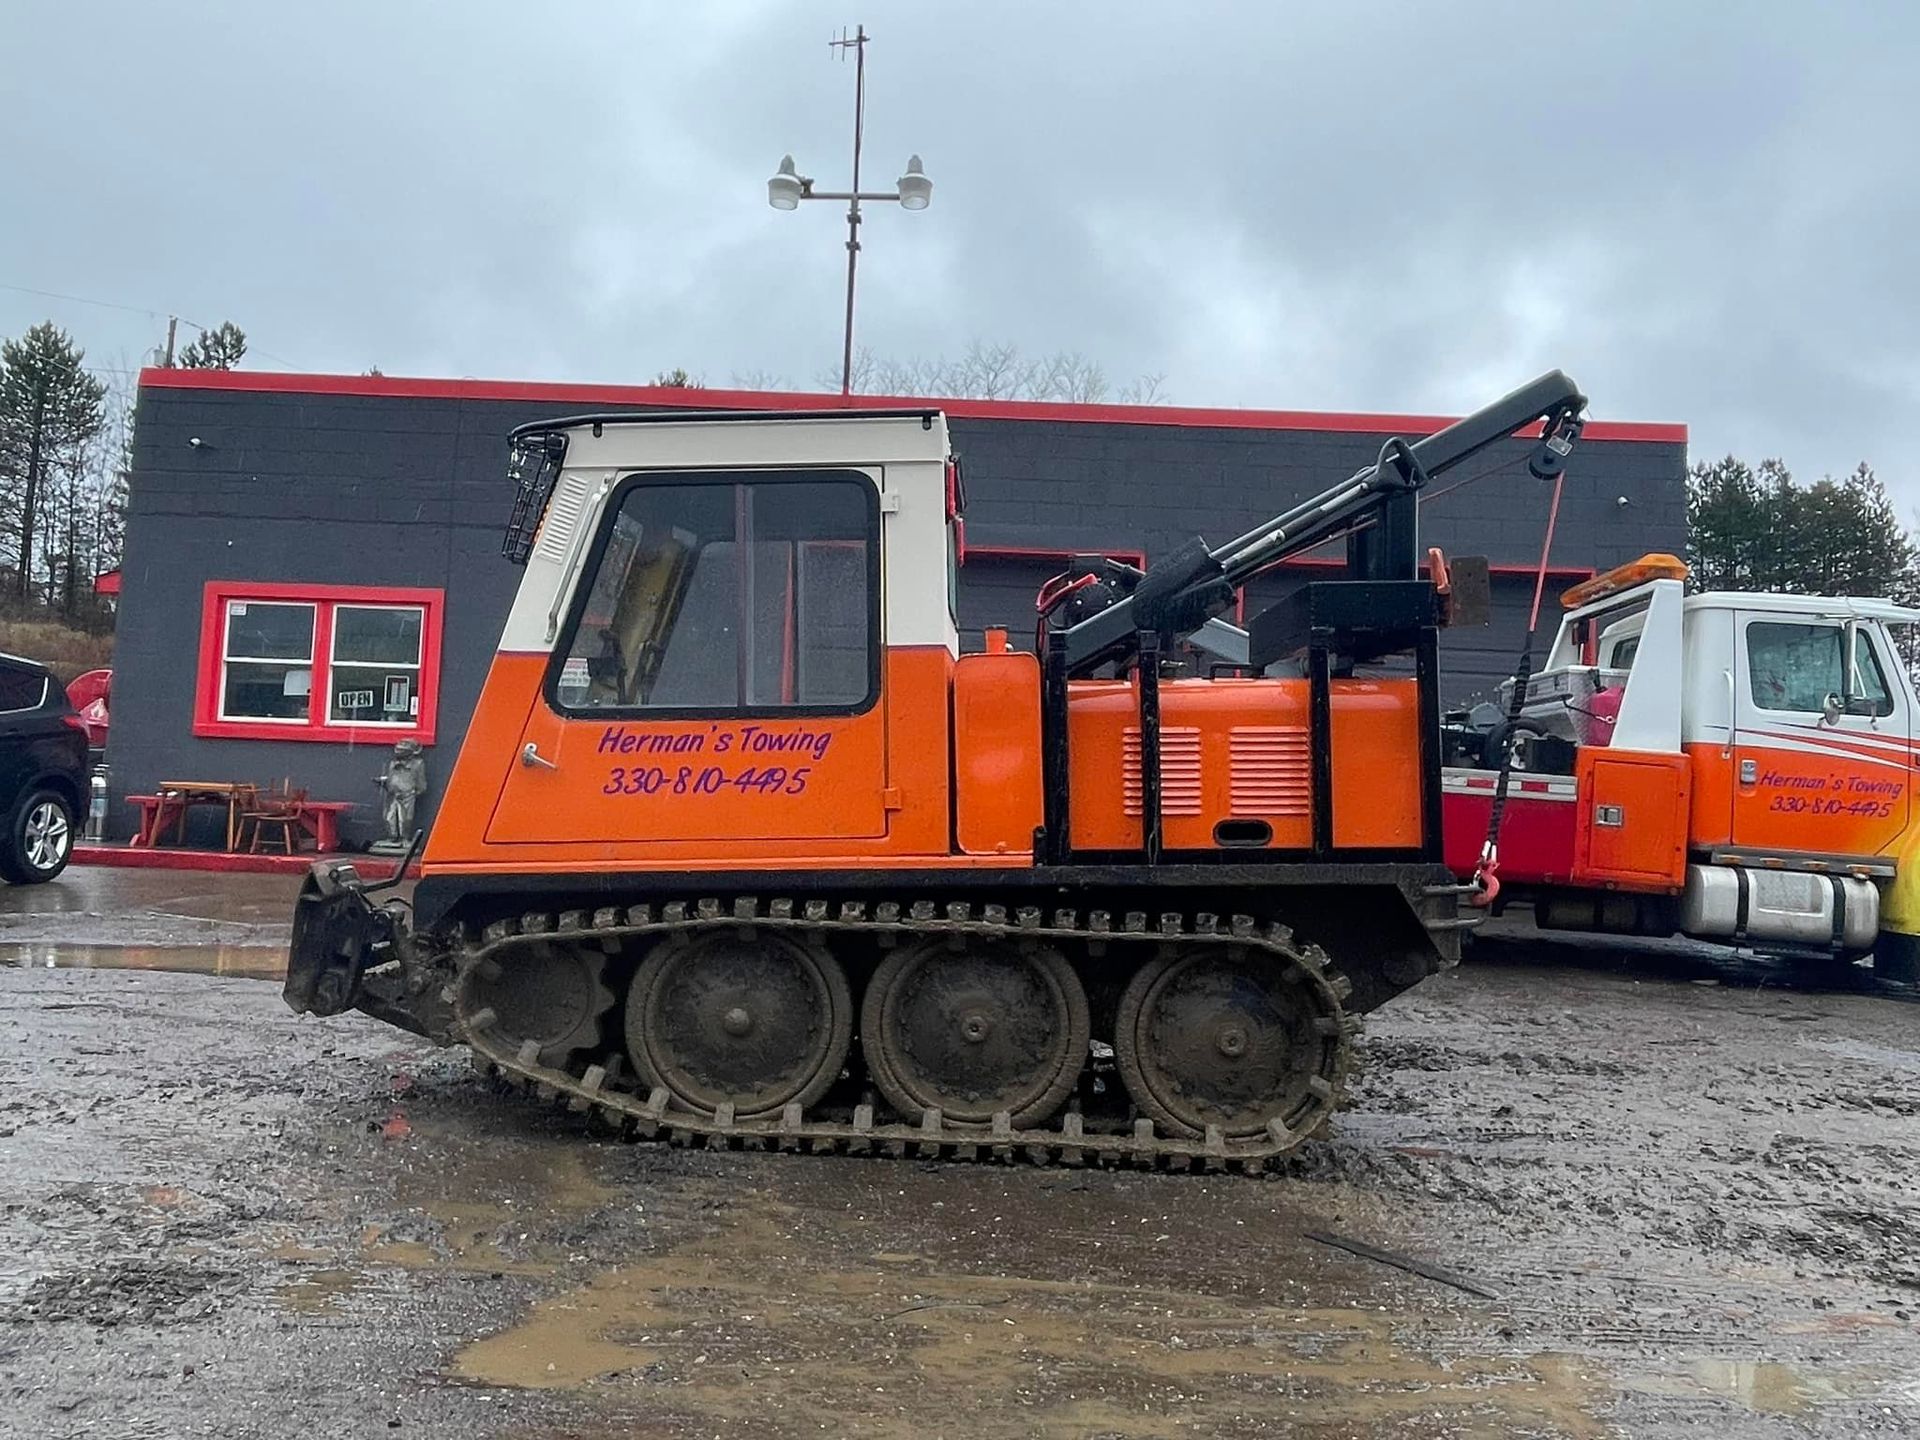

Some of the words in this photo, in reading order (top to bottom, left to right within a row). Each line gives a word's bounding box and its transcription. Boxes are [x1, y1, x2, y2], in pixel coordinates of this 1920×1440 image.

[341, 692, 371, 706] OPEN
[598, 725, 734, 753] Herman's
[740, 726, 832, 760] Towing
[603, 766, 811, 794] 330-810-4495
[1760, 770, 1844, 792] Herman's
[1848, 776, 1904, 800] Towing
[1770, 796, 1895, 818] 330-810-4495
